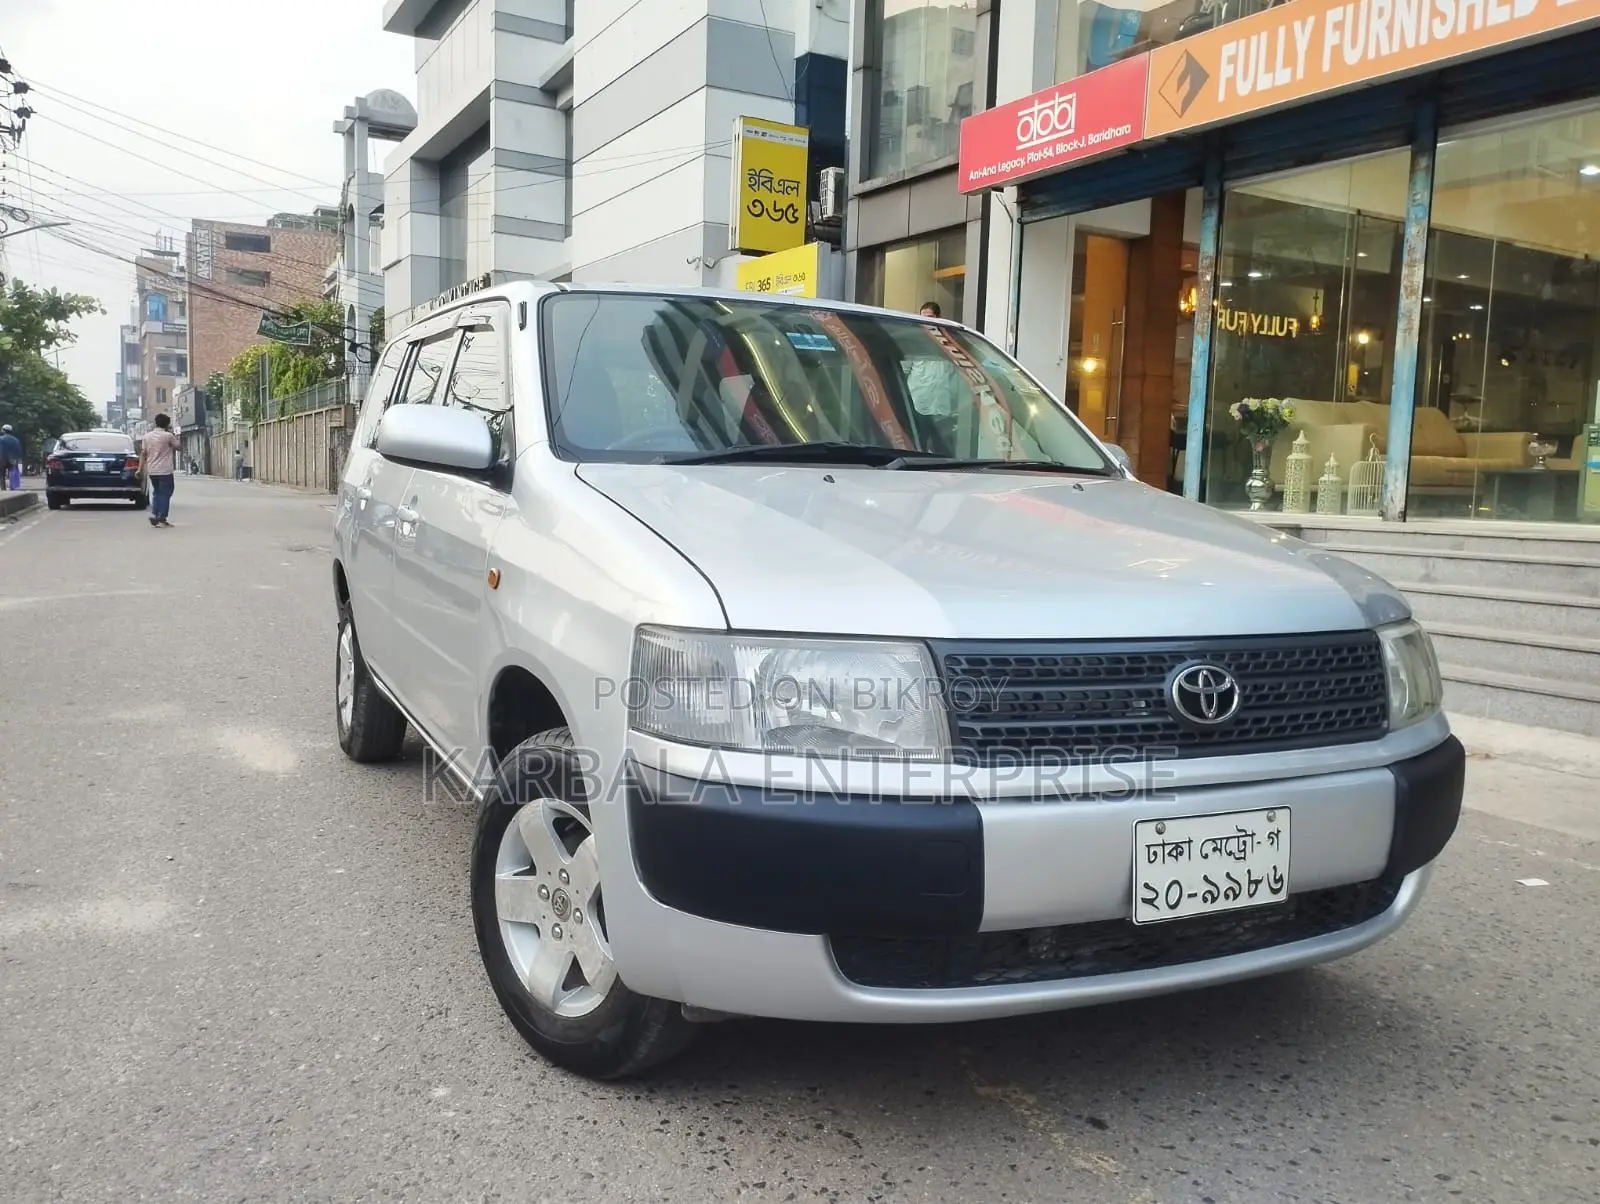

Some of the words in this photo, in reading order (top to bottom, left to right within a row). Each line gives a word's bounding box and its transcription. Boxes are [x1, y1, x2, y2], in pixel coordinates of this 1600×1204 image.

[1217, 16, 1314, 102] FULLY
[1322, 0, 1538, 72] FURNISH
[1016, 92, 1076, 149] otobi
[969, 166, 996, 181] Ani-Ana
[1088, 123, 1131, 145] Baridhara
[747, 168, 801, 197] ইবিএল
[747, 199, 799, 224] ৩৬৫
[757, 276, 771, 292] 365
[1145, 837, 1193, 864] ঢাকা
[1140, 865, 1284, 911] ২০-৯৯৮৬
